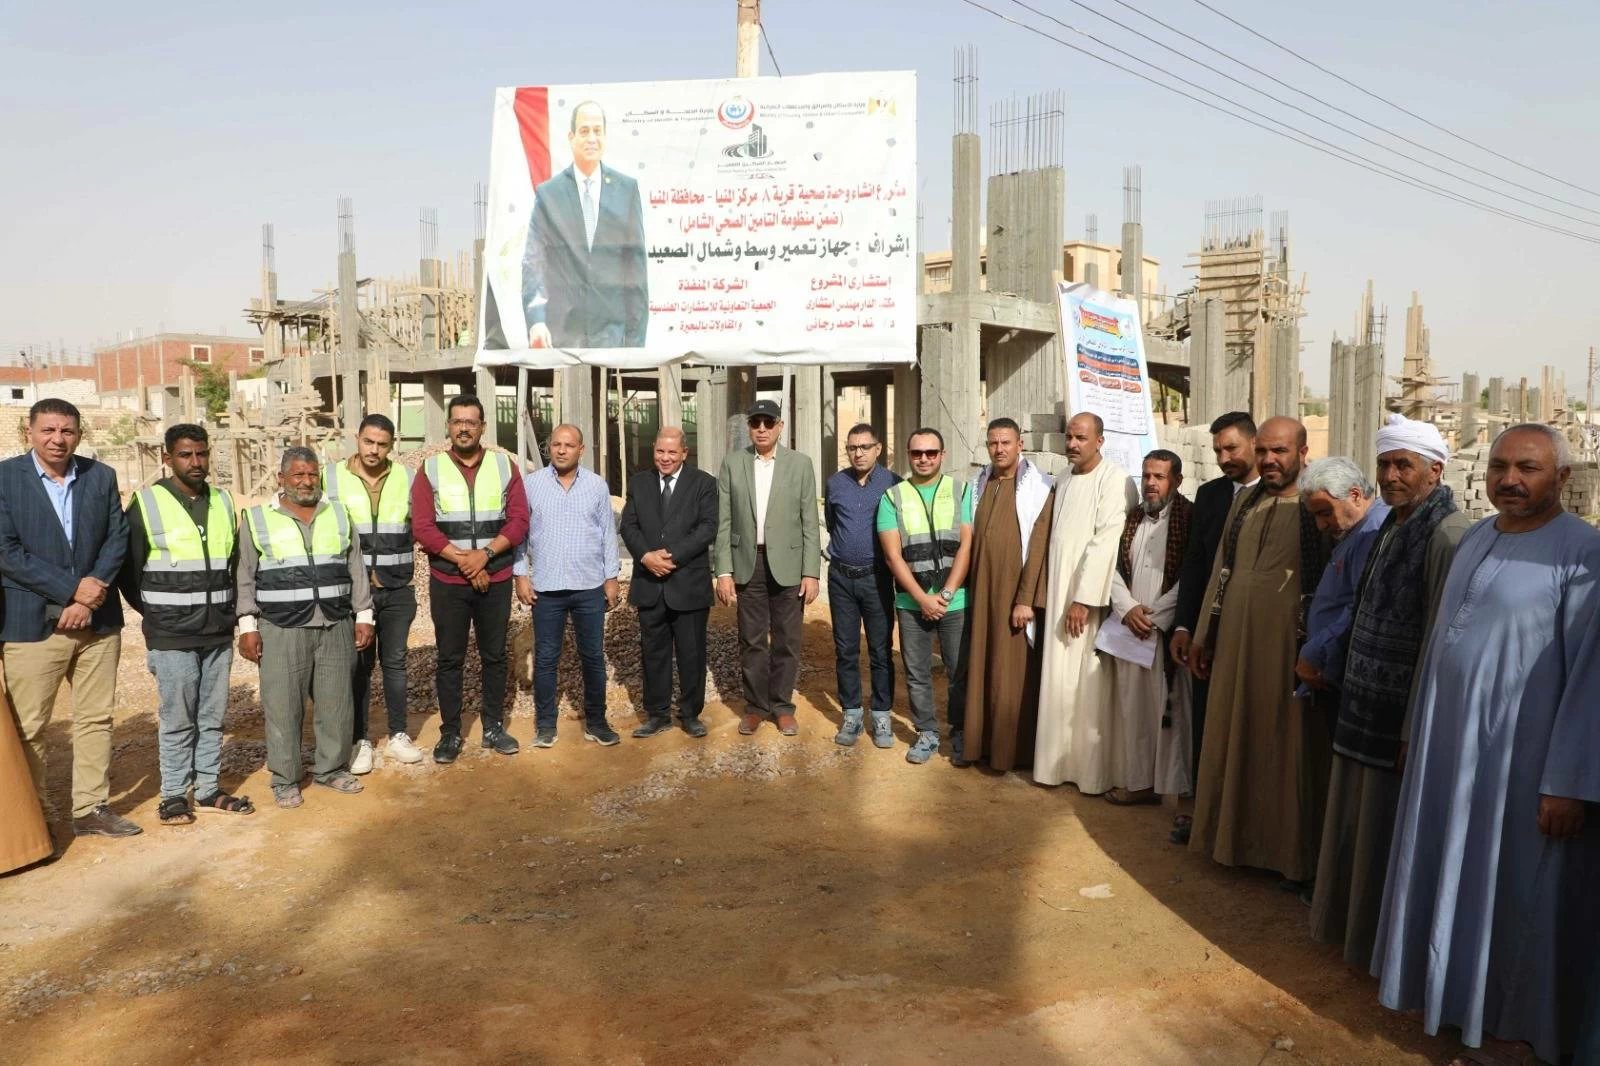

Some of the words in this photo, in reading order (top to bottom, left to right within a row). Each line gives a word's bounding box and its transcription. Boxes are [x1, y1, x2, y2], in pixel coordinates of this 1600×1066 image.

[649, 189, 669, 209] المنيا
[671, 188, 705, 204] محافظة
[714, 188, 735, 208] المنيا
[736, 187, 758, 207] مركز
[772, 184, 795, 208] قرية
[797, 183, 825, 205] صحية
[826, 184, 850, 203] وحدة
[780, 209, 814, 231] منظومة
[648, 241, 694, 264] الصعيد
[697, 238, 741, 262] وشمال
[743, 240, 775, 261] وسط
[777, 237, 817, 262] تعمير
[818, 237, 852, 259] جهاز
[868, 232, 909, 258] إشراف
[678, 278, 710, 291] المنفذة
[712, 277, 748, 293] الشركة
[811, 272, 847, 291] المشروع
